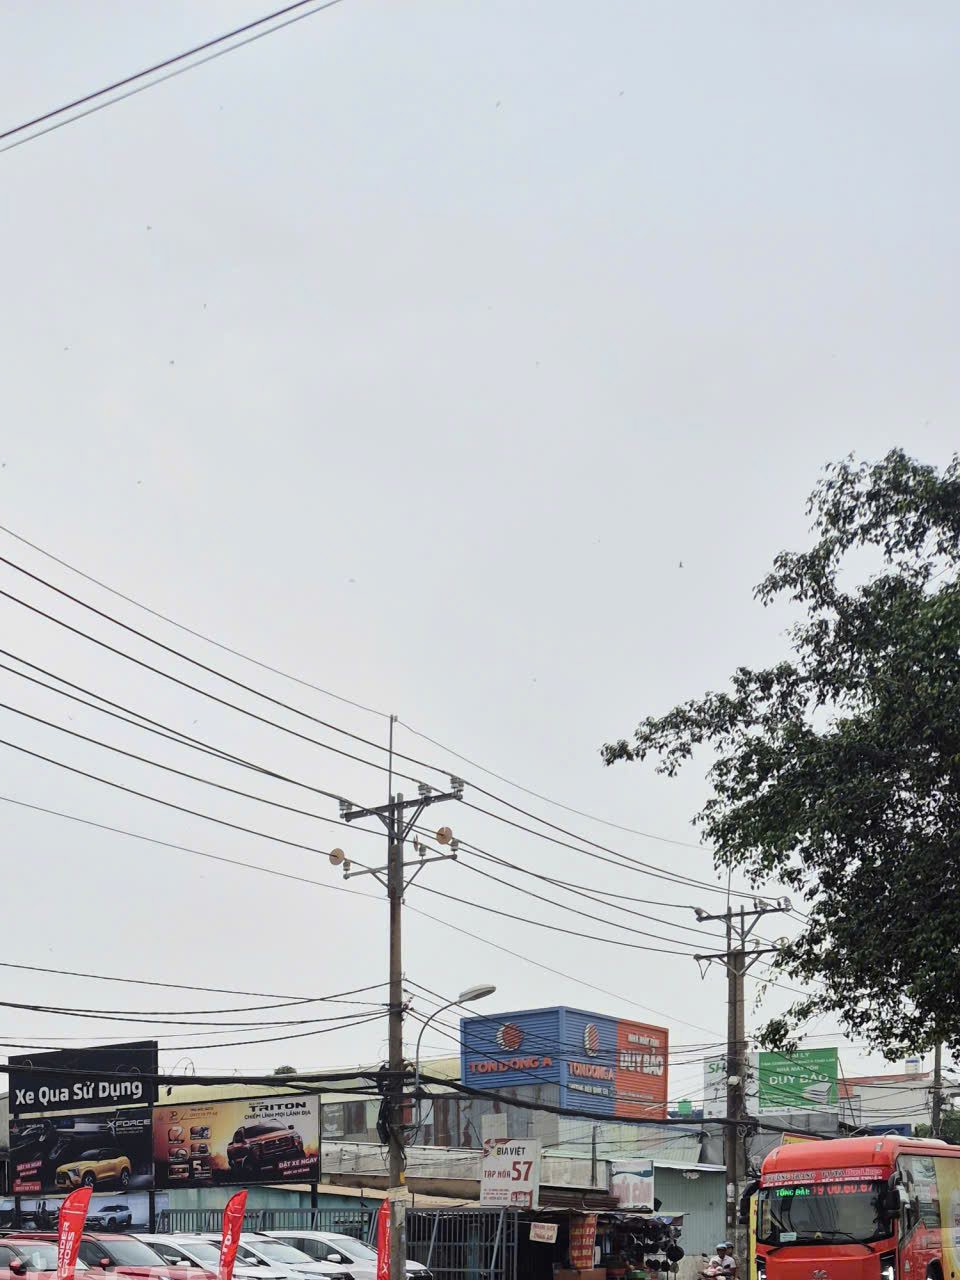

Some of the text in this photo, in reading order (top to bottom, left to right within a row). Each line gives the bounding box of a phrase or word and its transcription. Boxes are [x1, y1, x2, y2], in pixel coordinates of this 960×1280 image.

[620, 1049, 642, 1073] DUY
[769, 1075, 795, 1085] DUY
[15, 1081, 143, 1106] Xe Qua Sử Dụng
[249, 1102, 307, 1112] TRITON
[107, 1119, 151, 1129] XFORCE
[496, 1146, 526, 1156] BIA VIỆT
[512, 1161, 533, 1181] 57
[61, 1232, 76, 1277] CROSS
